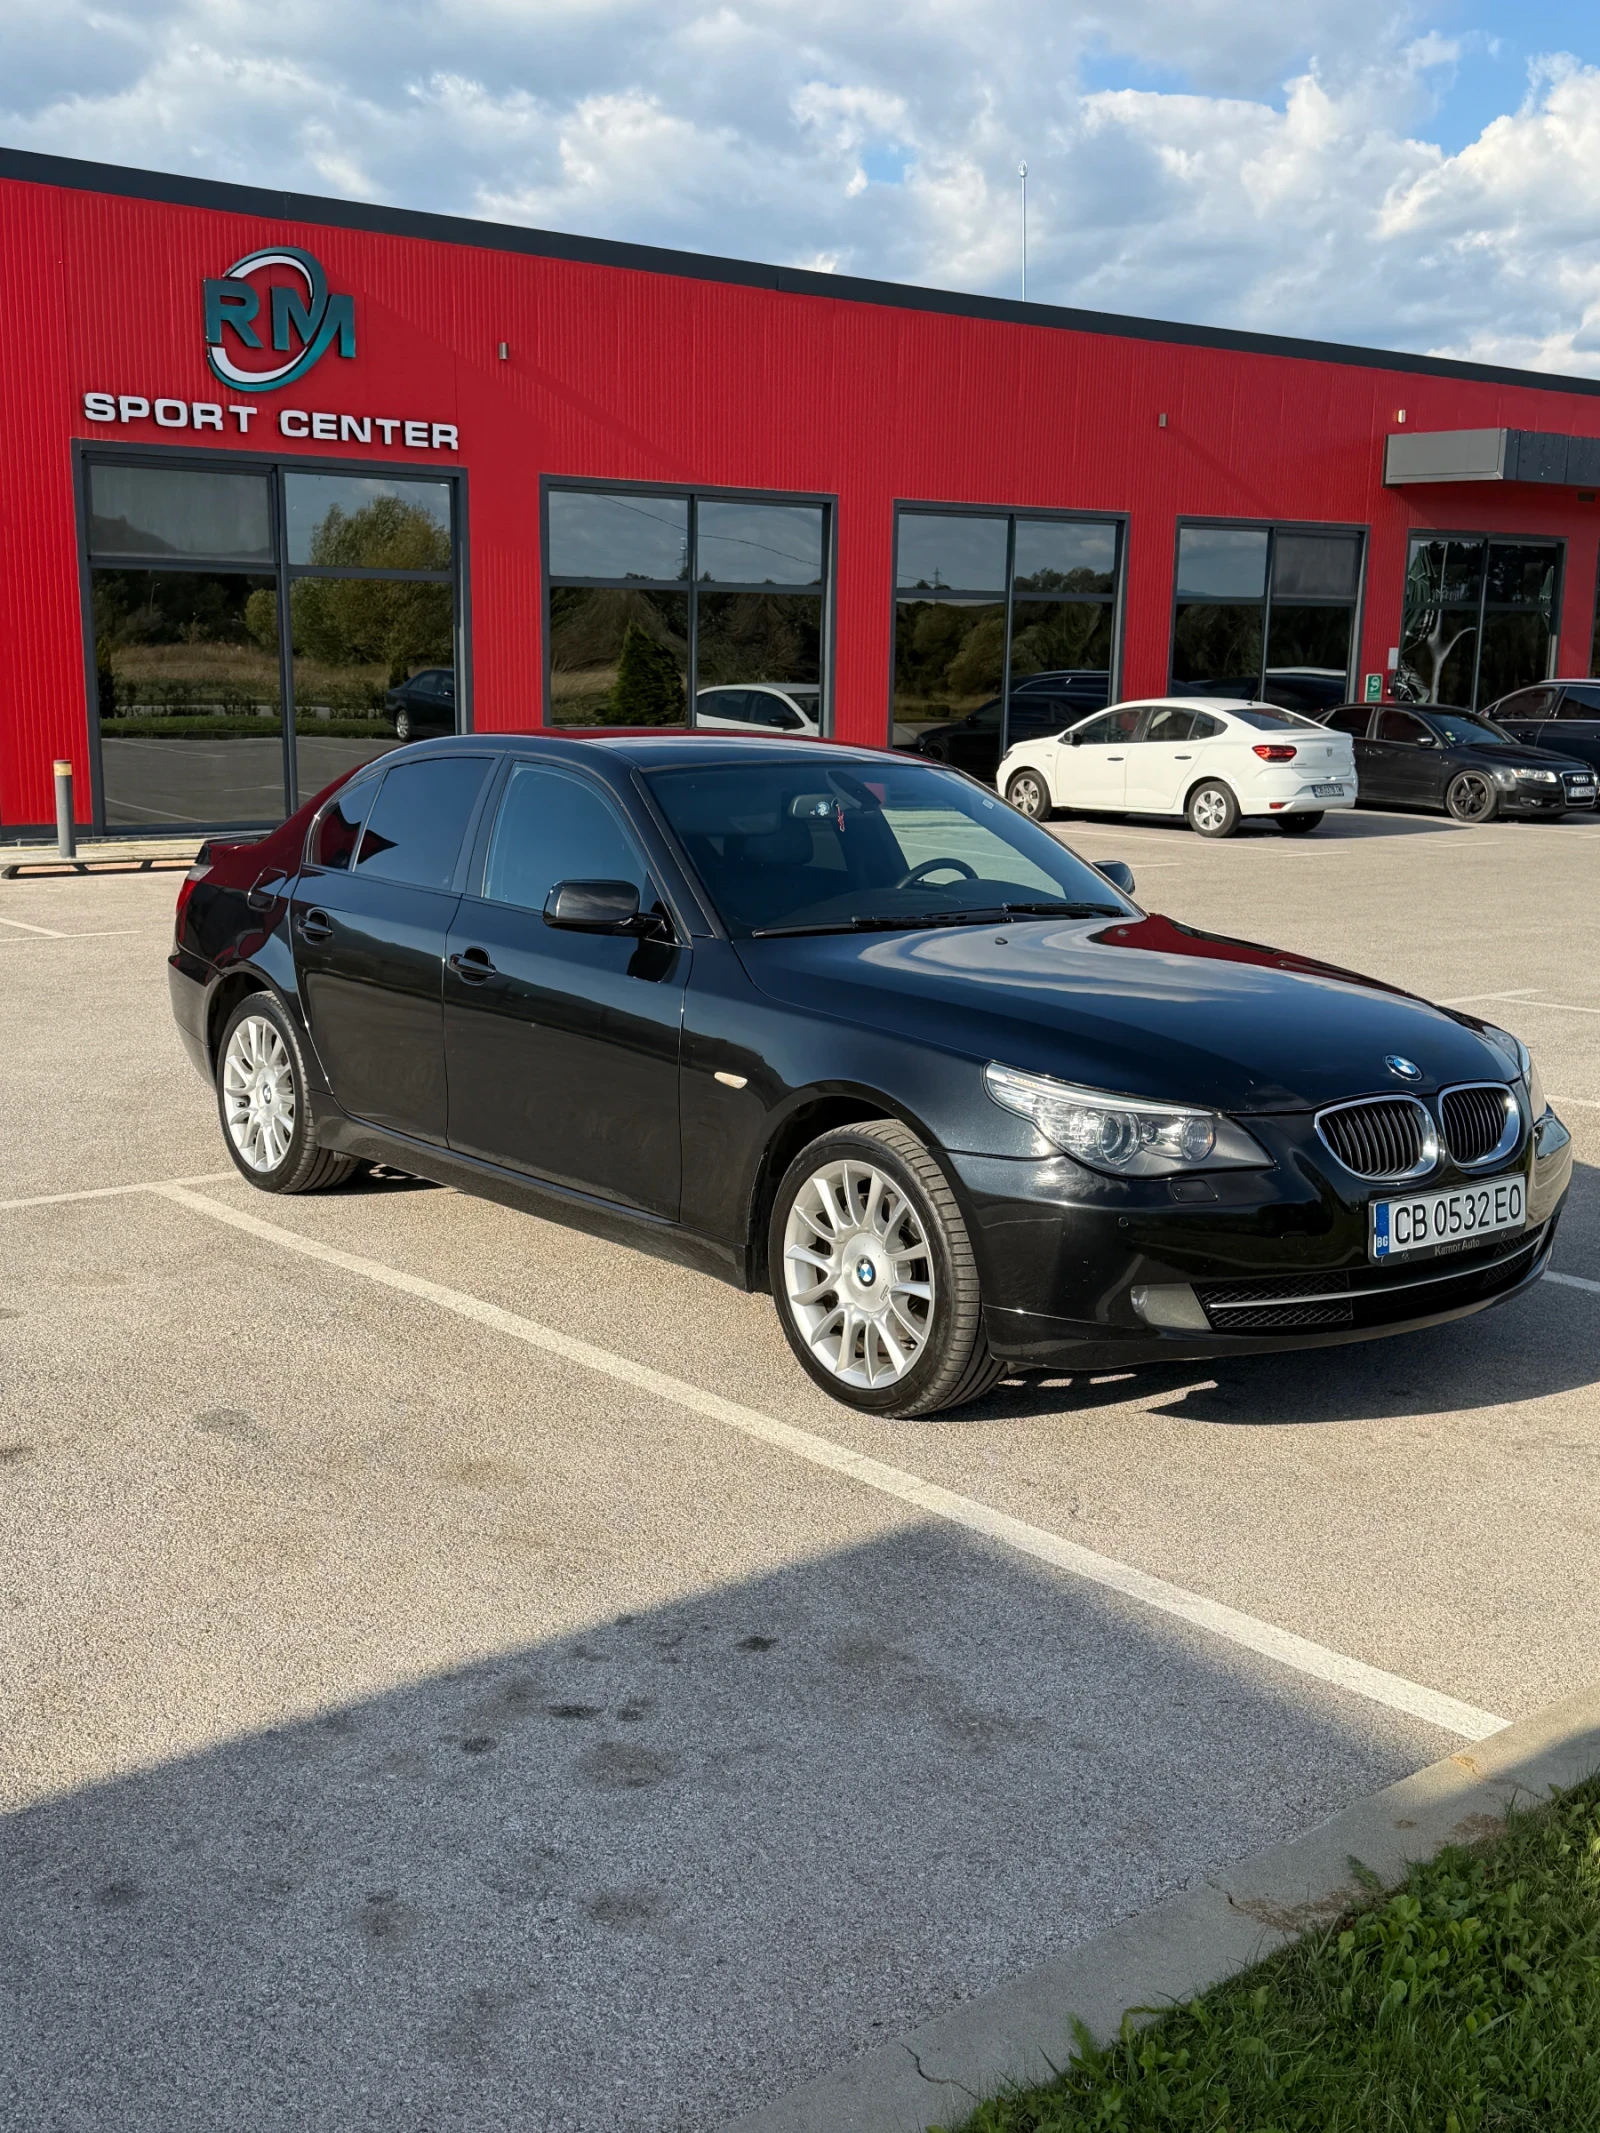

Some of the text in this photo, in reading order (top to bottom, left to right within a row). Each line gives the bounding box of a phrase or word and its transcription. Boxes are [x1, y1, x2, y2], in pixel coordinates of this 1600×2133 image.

[204, 277, 356, 359] RM
[84, 392, 459, 451] SPORT CENTER
[1376, 1235, 1389, 1248] BG
[1394, 1203, 1428, 1245] CB
[1433, 1191, 1490, 1237] 0532
[1461, 1238, 1480, 1251] Auto
